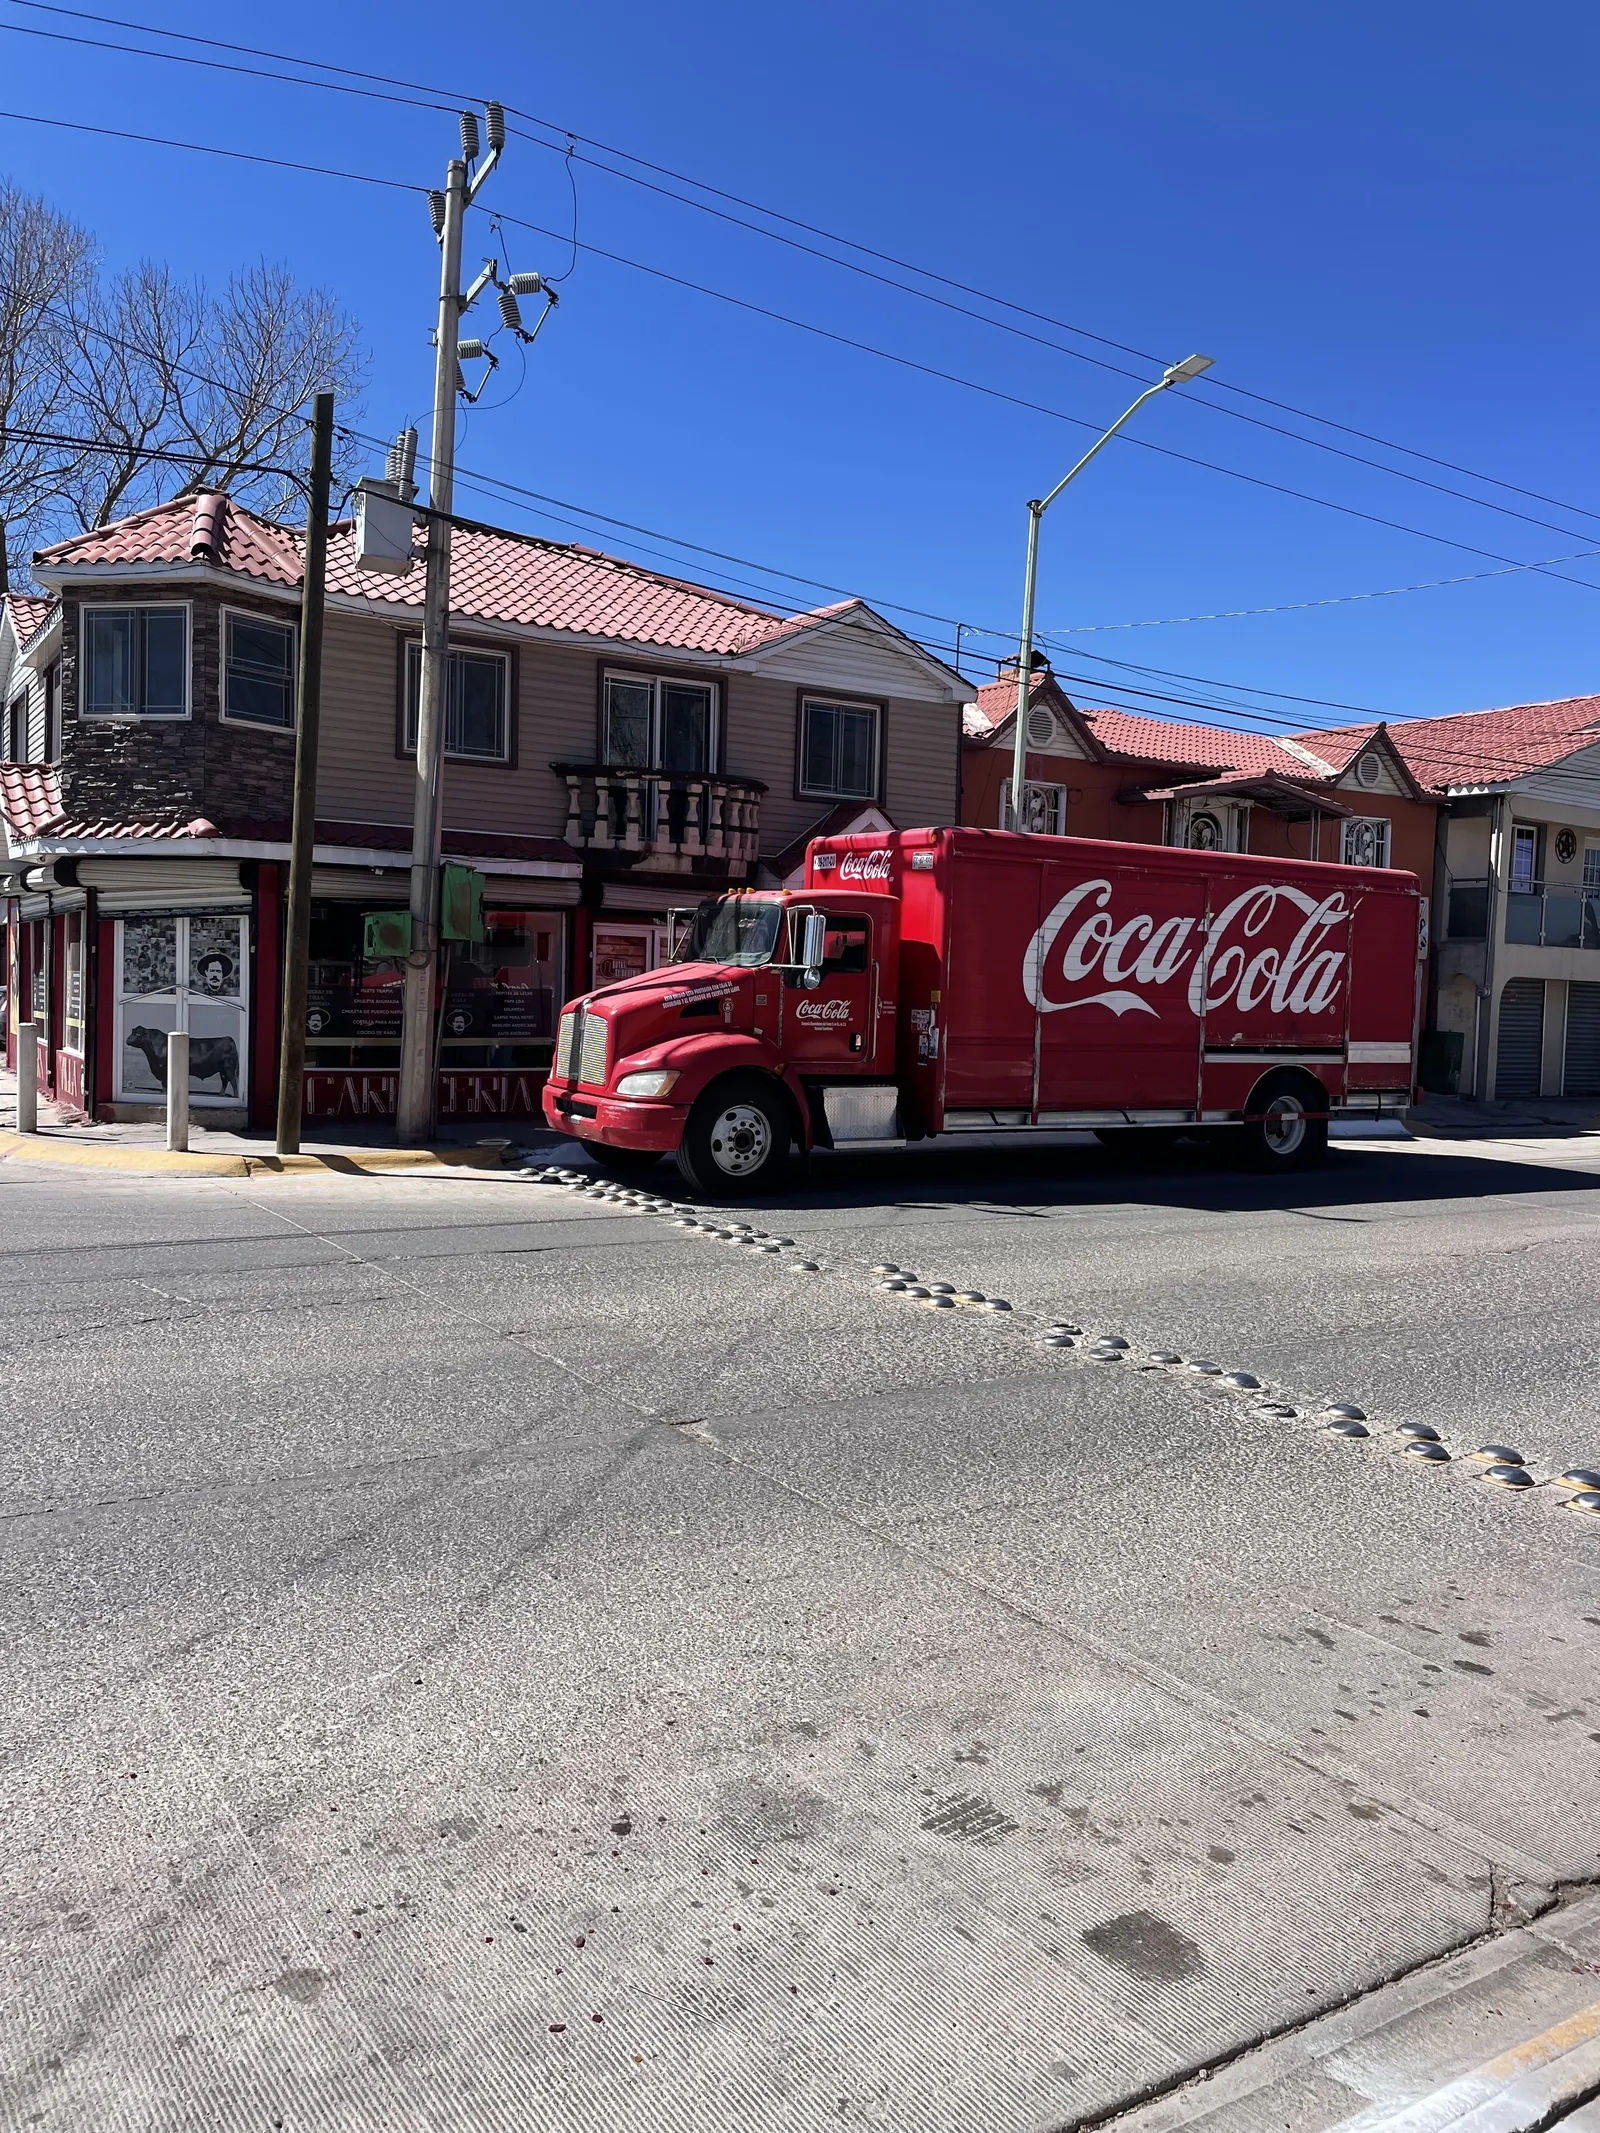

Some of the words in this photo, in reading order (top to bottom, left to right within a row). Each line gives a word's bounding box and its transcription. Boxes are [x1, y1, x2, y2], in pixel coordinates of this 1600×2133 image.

[840, 849, 894, 881] Coca-Cola
[1022, 879, 1364, 1019] Coca-Cola
[795, 999, 852, 1019] Coca-Cola
